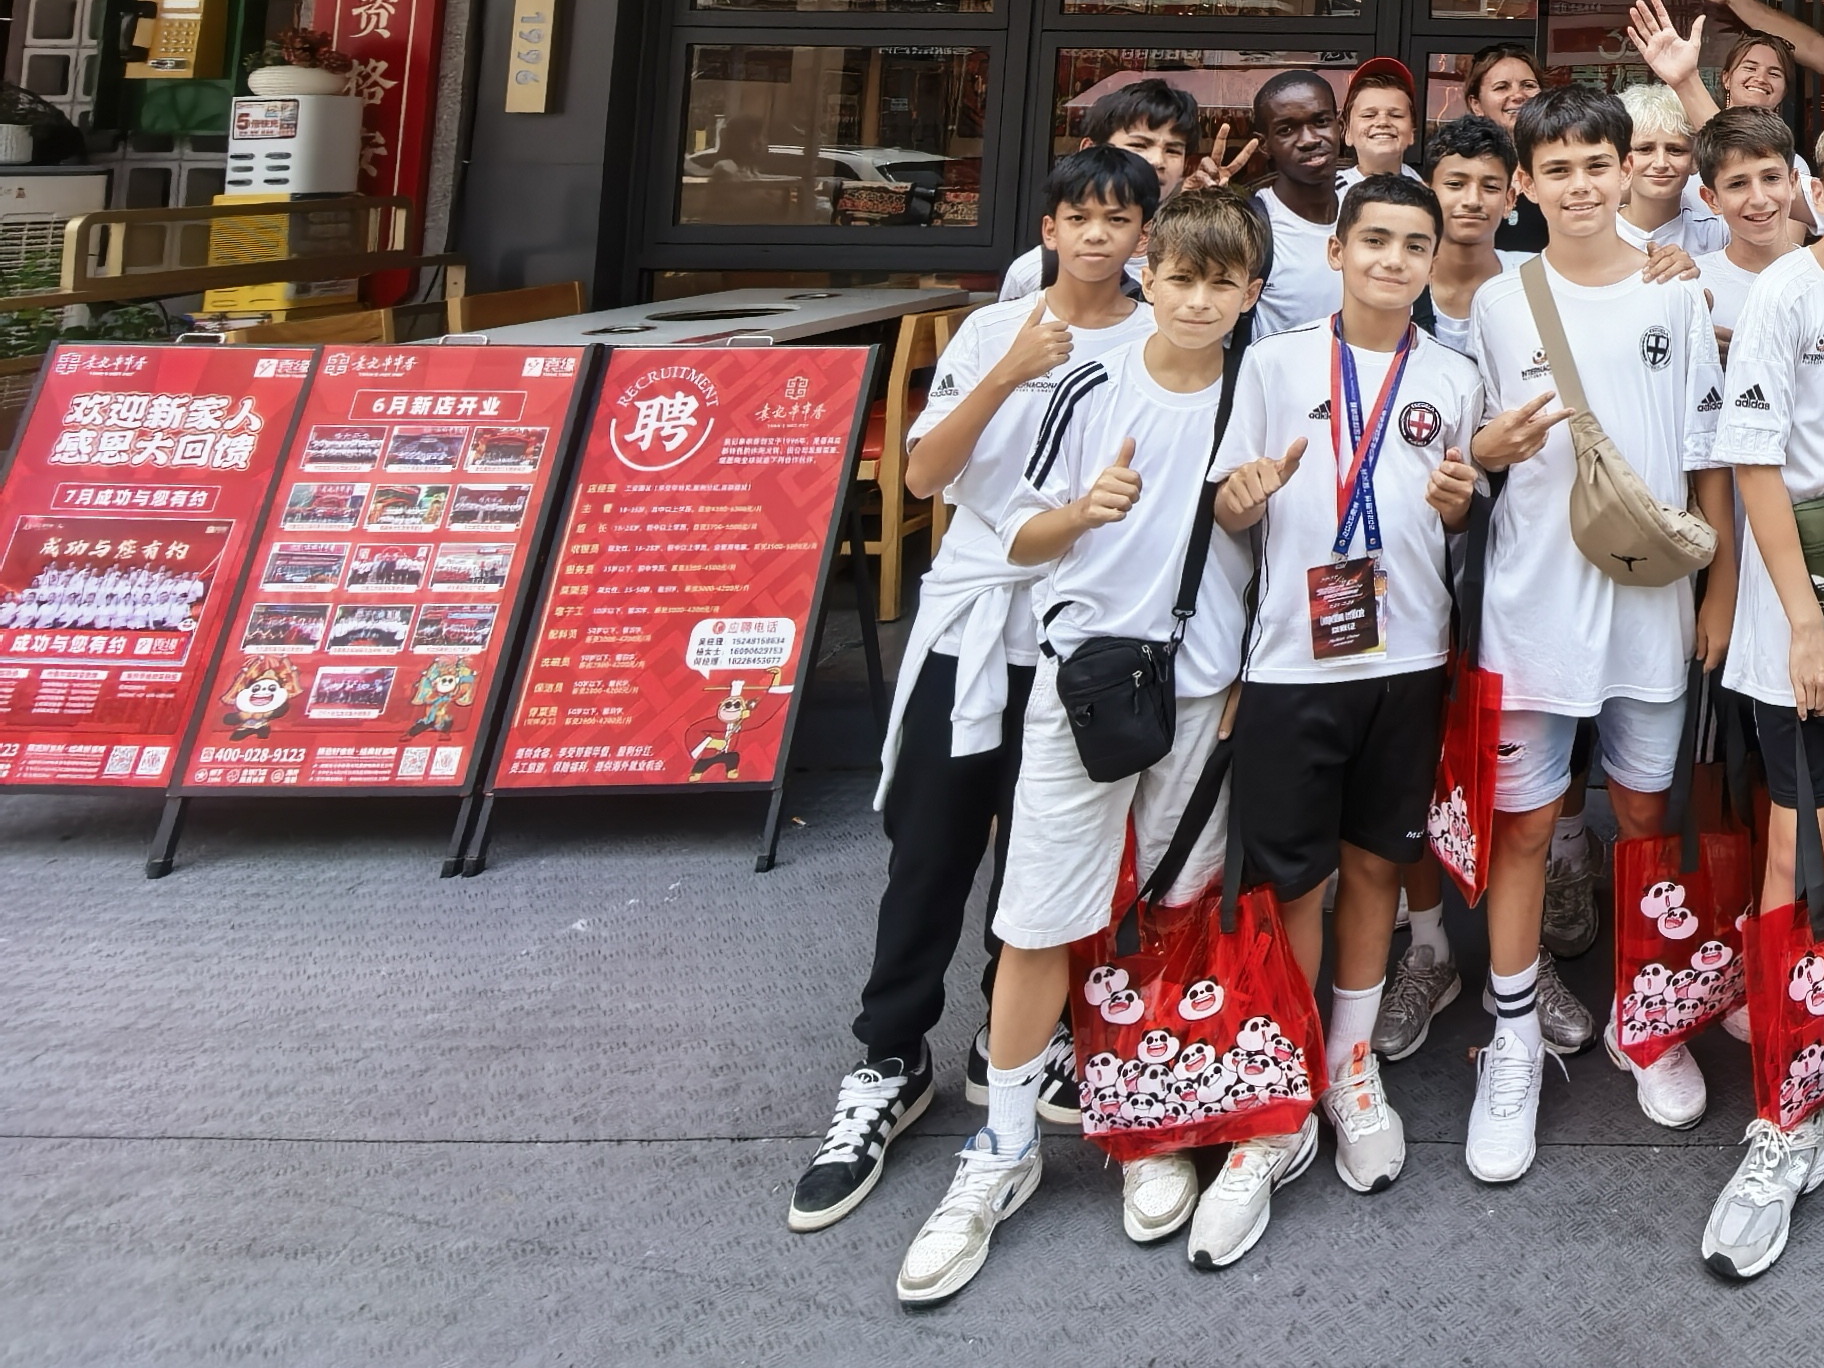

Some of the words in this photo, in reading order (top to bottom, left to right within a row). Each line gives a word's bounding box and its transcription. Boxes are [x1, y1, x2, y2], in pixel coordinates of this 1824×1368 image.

[514, 12, 545, 86] 1996
[617, 366, 720, 408] RECRUITMENT
[63, 394, 264, 433] 欢迎新家人
[372, 395, 502, 416] 6月新店开业
[1308, 411, 1331, 420] adid
[1735, 398, 1770, 411] adidas
[624, 391, 700, 452] 聘
[50, 429, 256, 470] 感恩大回馈
[63, 488, 209, 509] 7月成功与您有约
[40, 537, 191, 561] 成功与您有约
[10, 634, 127, 655] 成功与您有约
[214, 747, 306, 762] 400-028-9123
